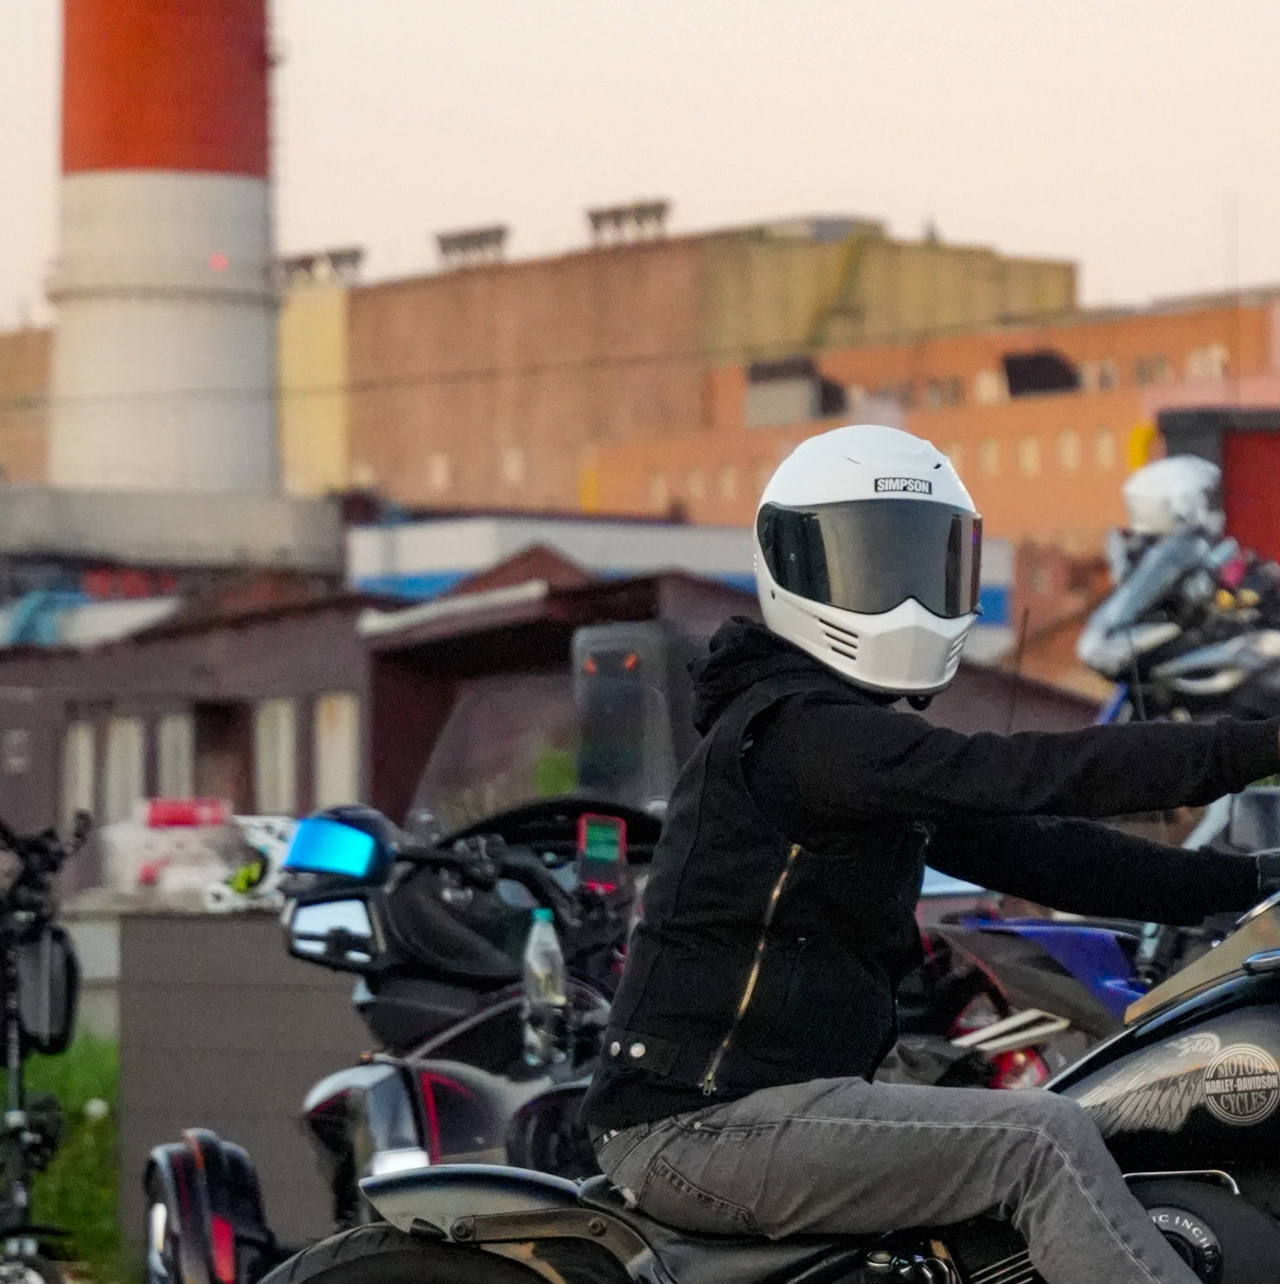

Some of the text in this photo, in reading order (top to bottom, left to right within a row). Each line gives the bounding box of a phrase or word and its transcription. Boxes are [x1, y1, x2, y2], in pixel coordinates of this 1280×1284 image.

[877, 478, 930, 493] SIMPSON
[1218, 1054, 1265, 1078] MOTOR
[1205, 1074, 1279, 1095] HARLEY-DAVIDSON
[1220, 1091, 1267, 1114] CYCLES
[1174, 1216, 1215, 1273] INCHES
